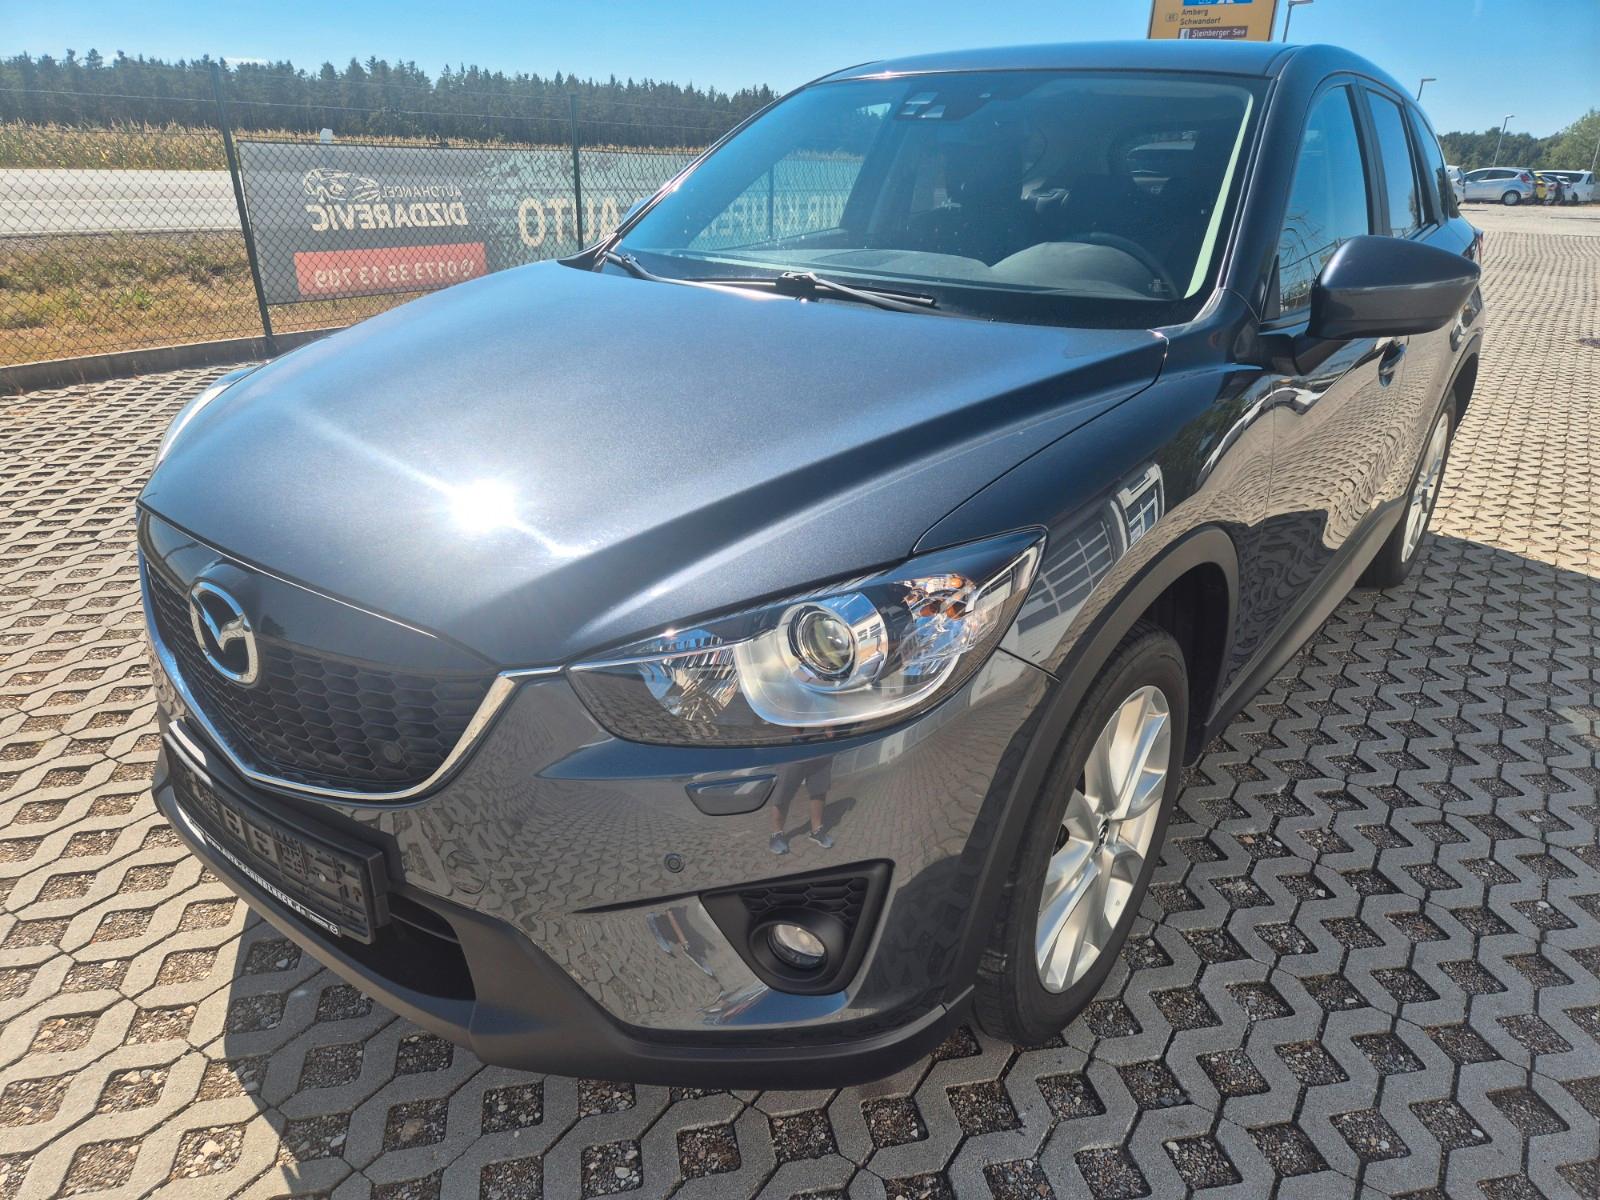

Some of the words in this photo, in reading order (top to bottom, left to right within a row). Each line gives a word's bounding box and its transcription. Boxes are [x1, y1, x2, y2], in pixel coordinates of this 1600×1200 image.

[1181, 8, 1209, 17] Amberg
[1179, 17, 1221, 26] Schwandorf
[1191, 28, 1230, 38] Steinberger
[1232, 28, 1246, 36] See
